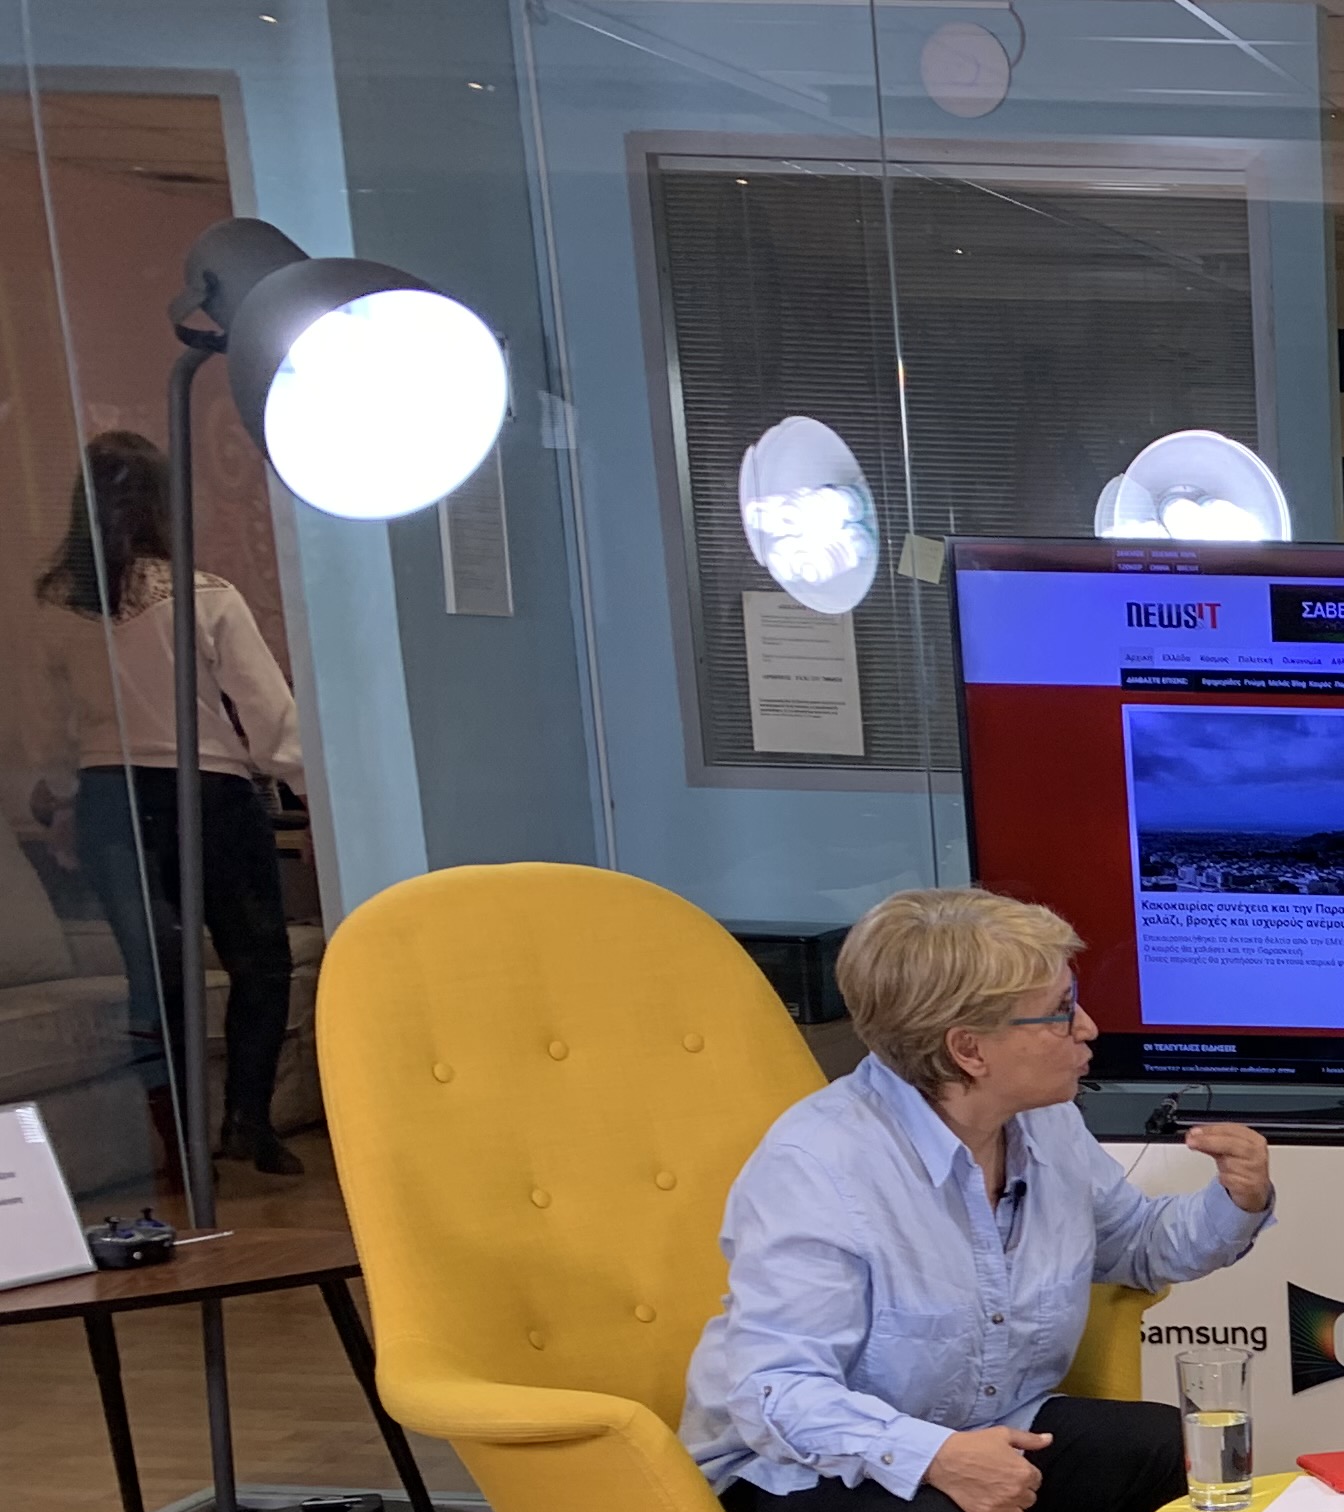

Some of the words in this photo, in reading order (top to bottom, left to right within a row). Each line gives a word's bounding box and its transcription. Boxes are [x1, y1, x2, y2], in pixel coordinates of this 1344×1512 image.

[1141, 900, 1214, 913] Κακοκαιρίας
[1217, 901, 1269, 914] συνέχεια
[1272, 904, 1290, 913] και
[1293, 904, 1312, 915] την
[1142, 914, 1183, 926] χαλάζι,
[1186, 915, 1227, 928] βροχές
[1231, 918, 1249, 926] και
[1252, 917, 1303, 929] ισχυρούς
